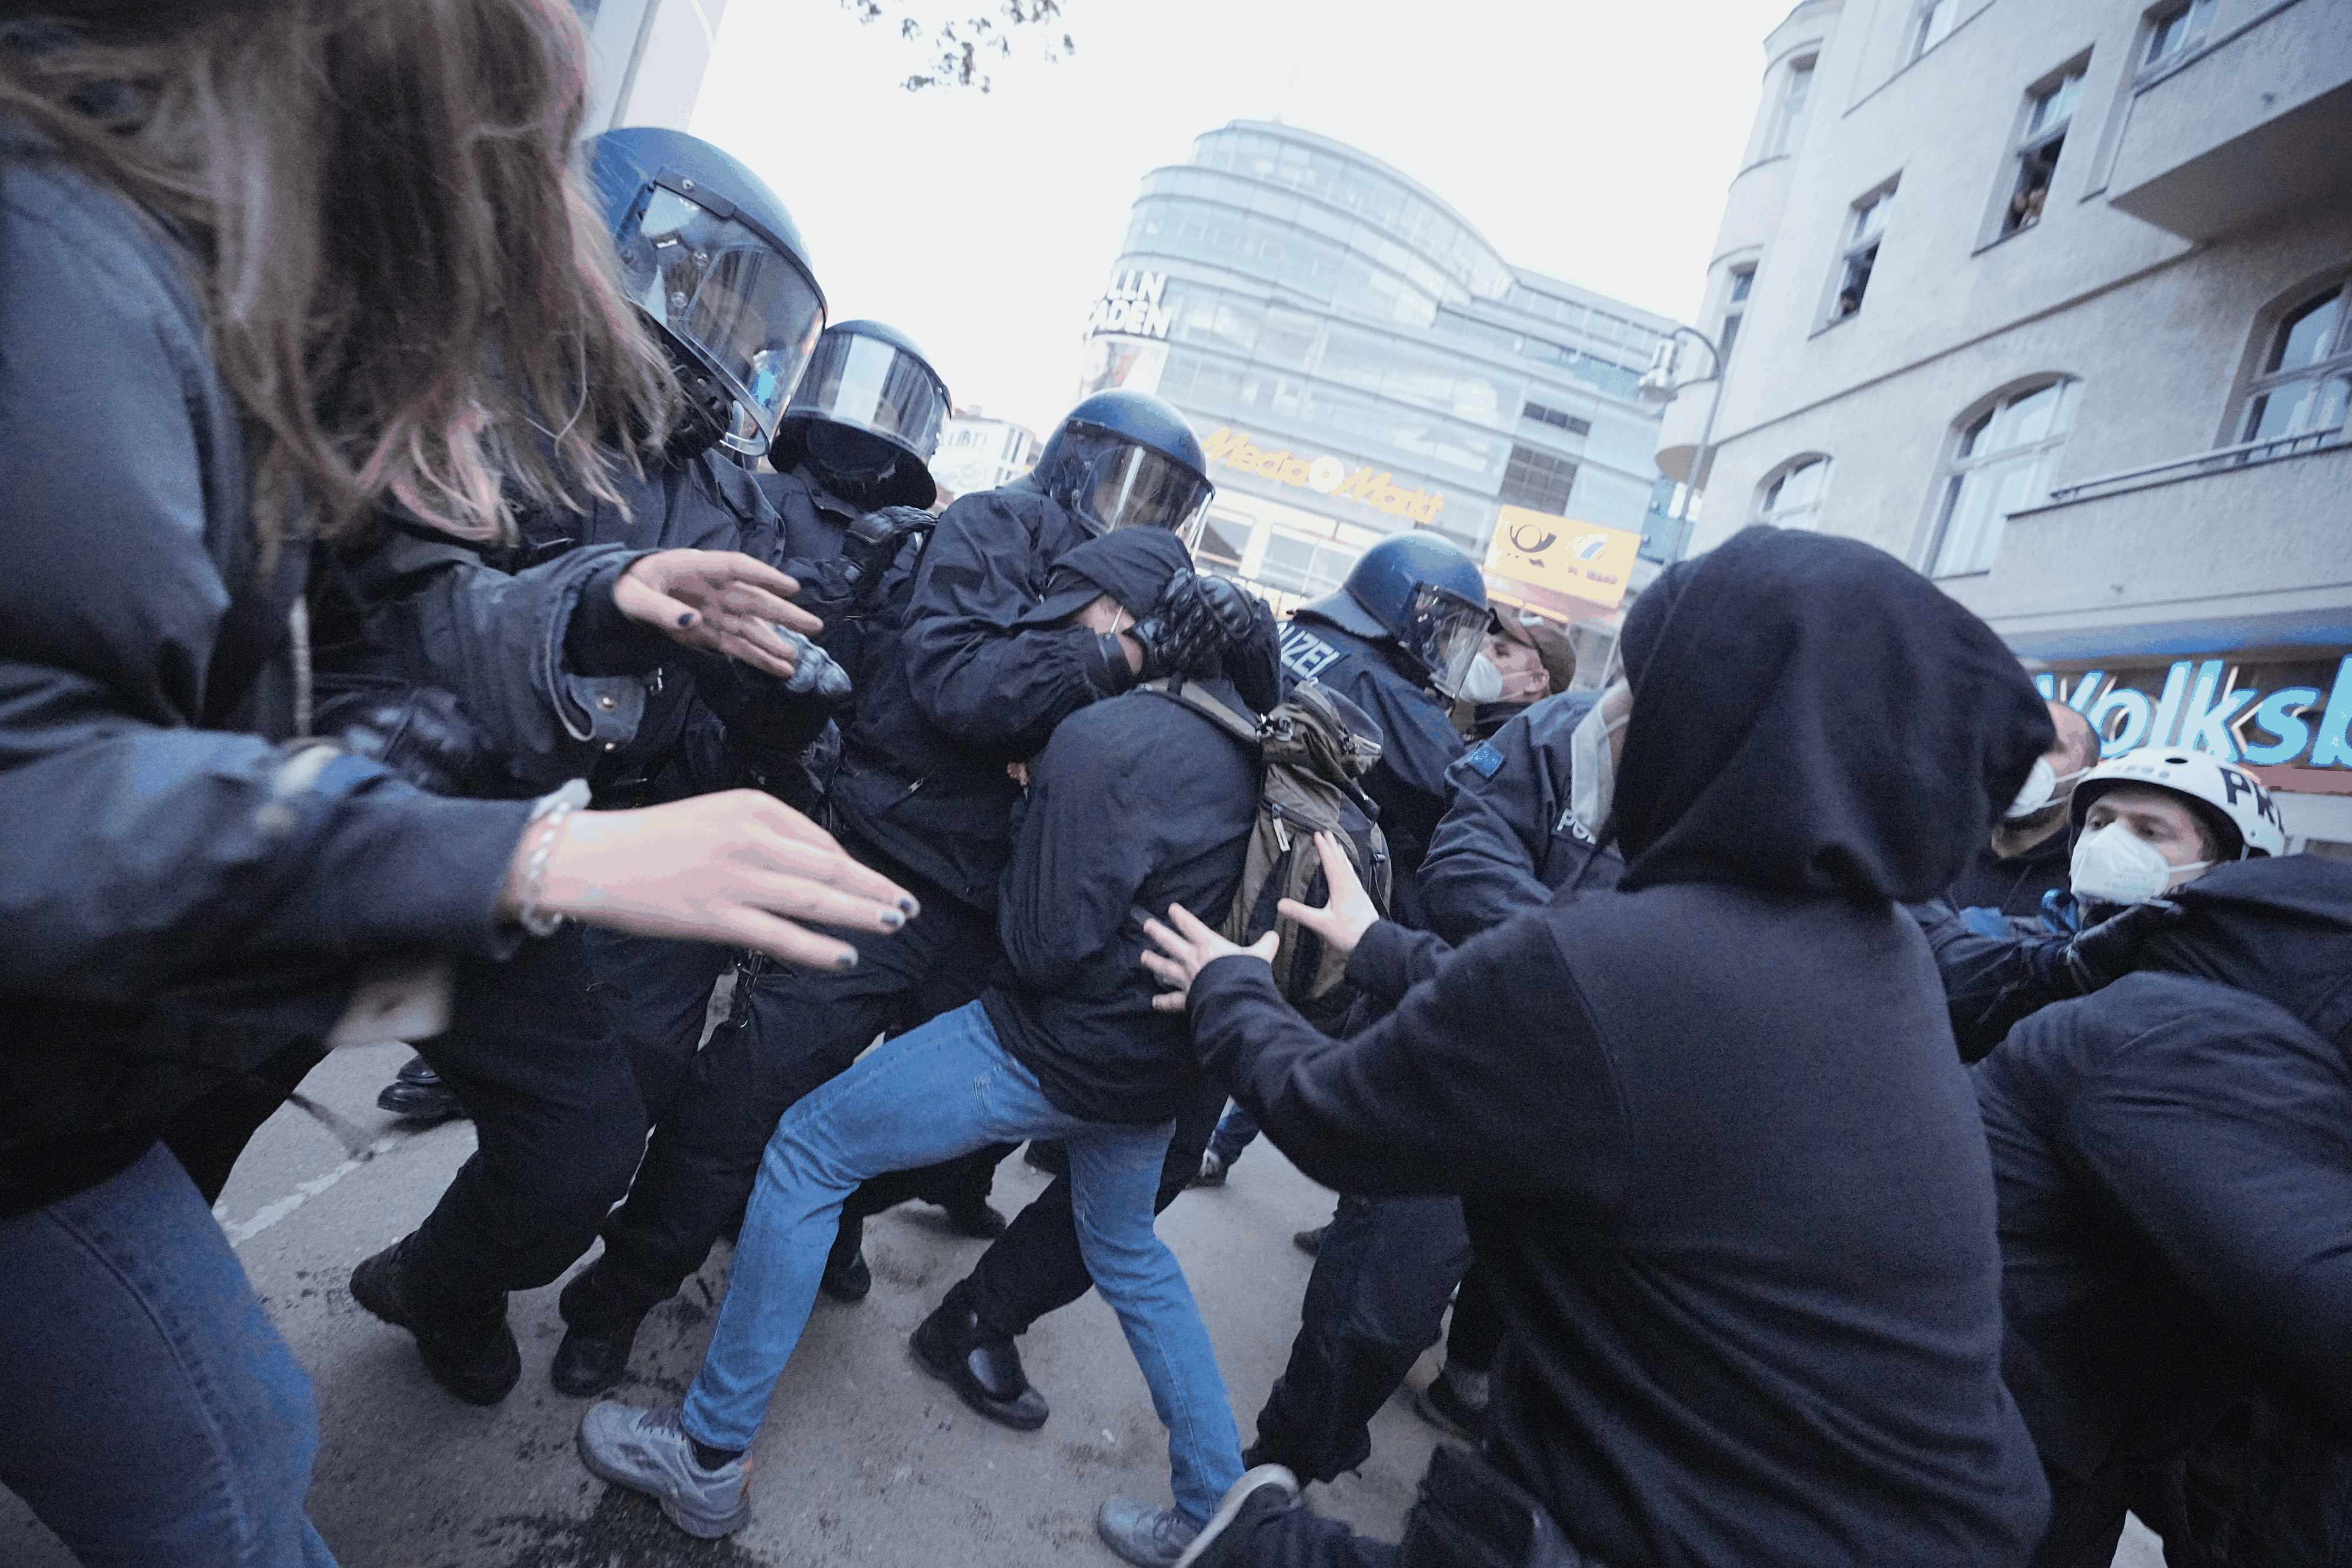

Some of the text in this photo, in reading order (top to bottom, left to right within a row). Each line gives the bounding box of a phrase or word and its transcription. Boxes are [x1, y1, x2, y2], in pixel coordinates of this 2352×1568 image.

[1098, 269, 1166, 305] LLN
[1202, 427, 1445, 525] Media Markt
[1556, 808, 1596, 845] PO
